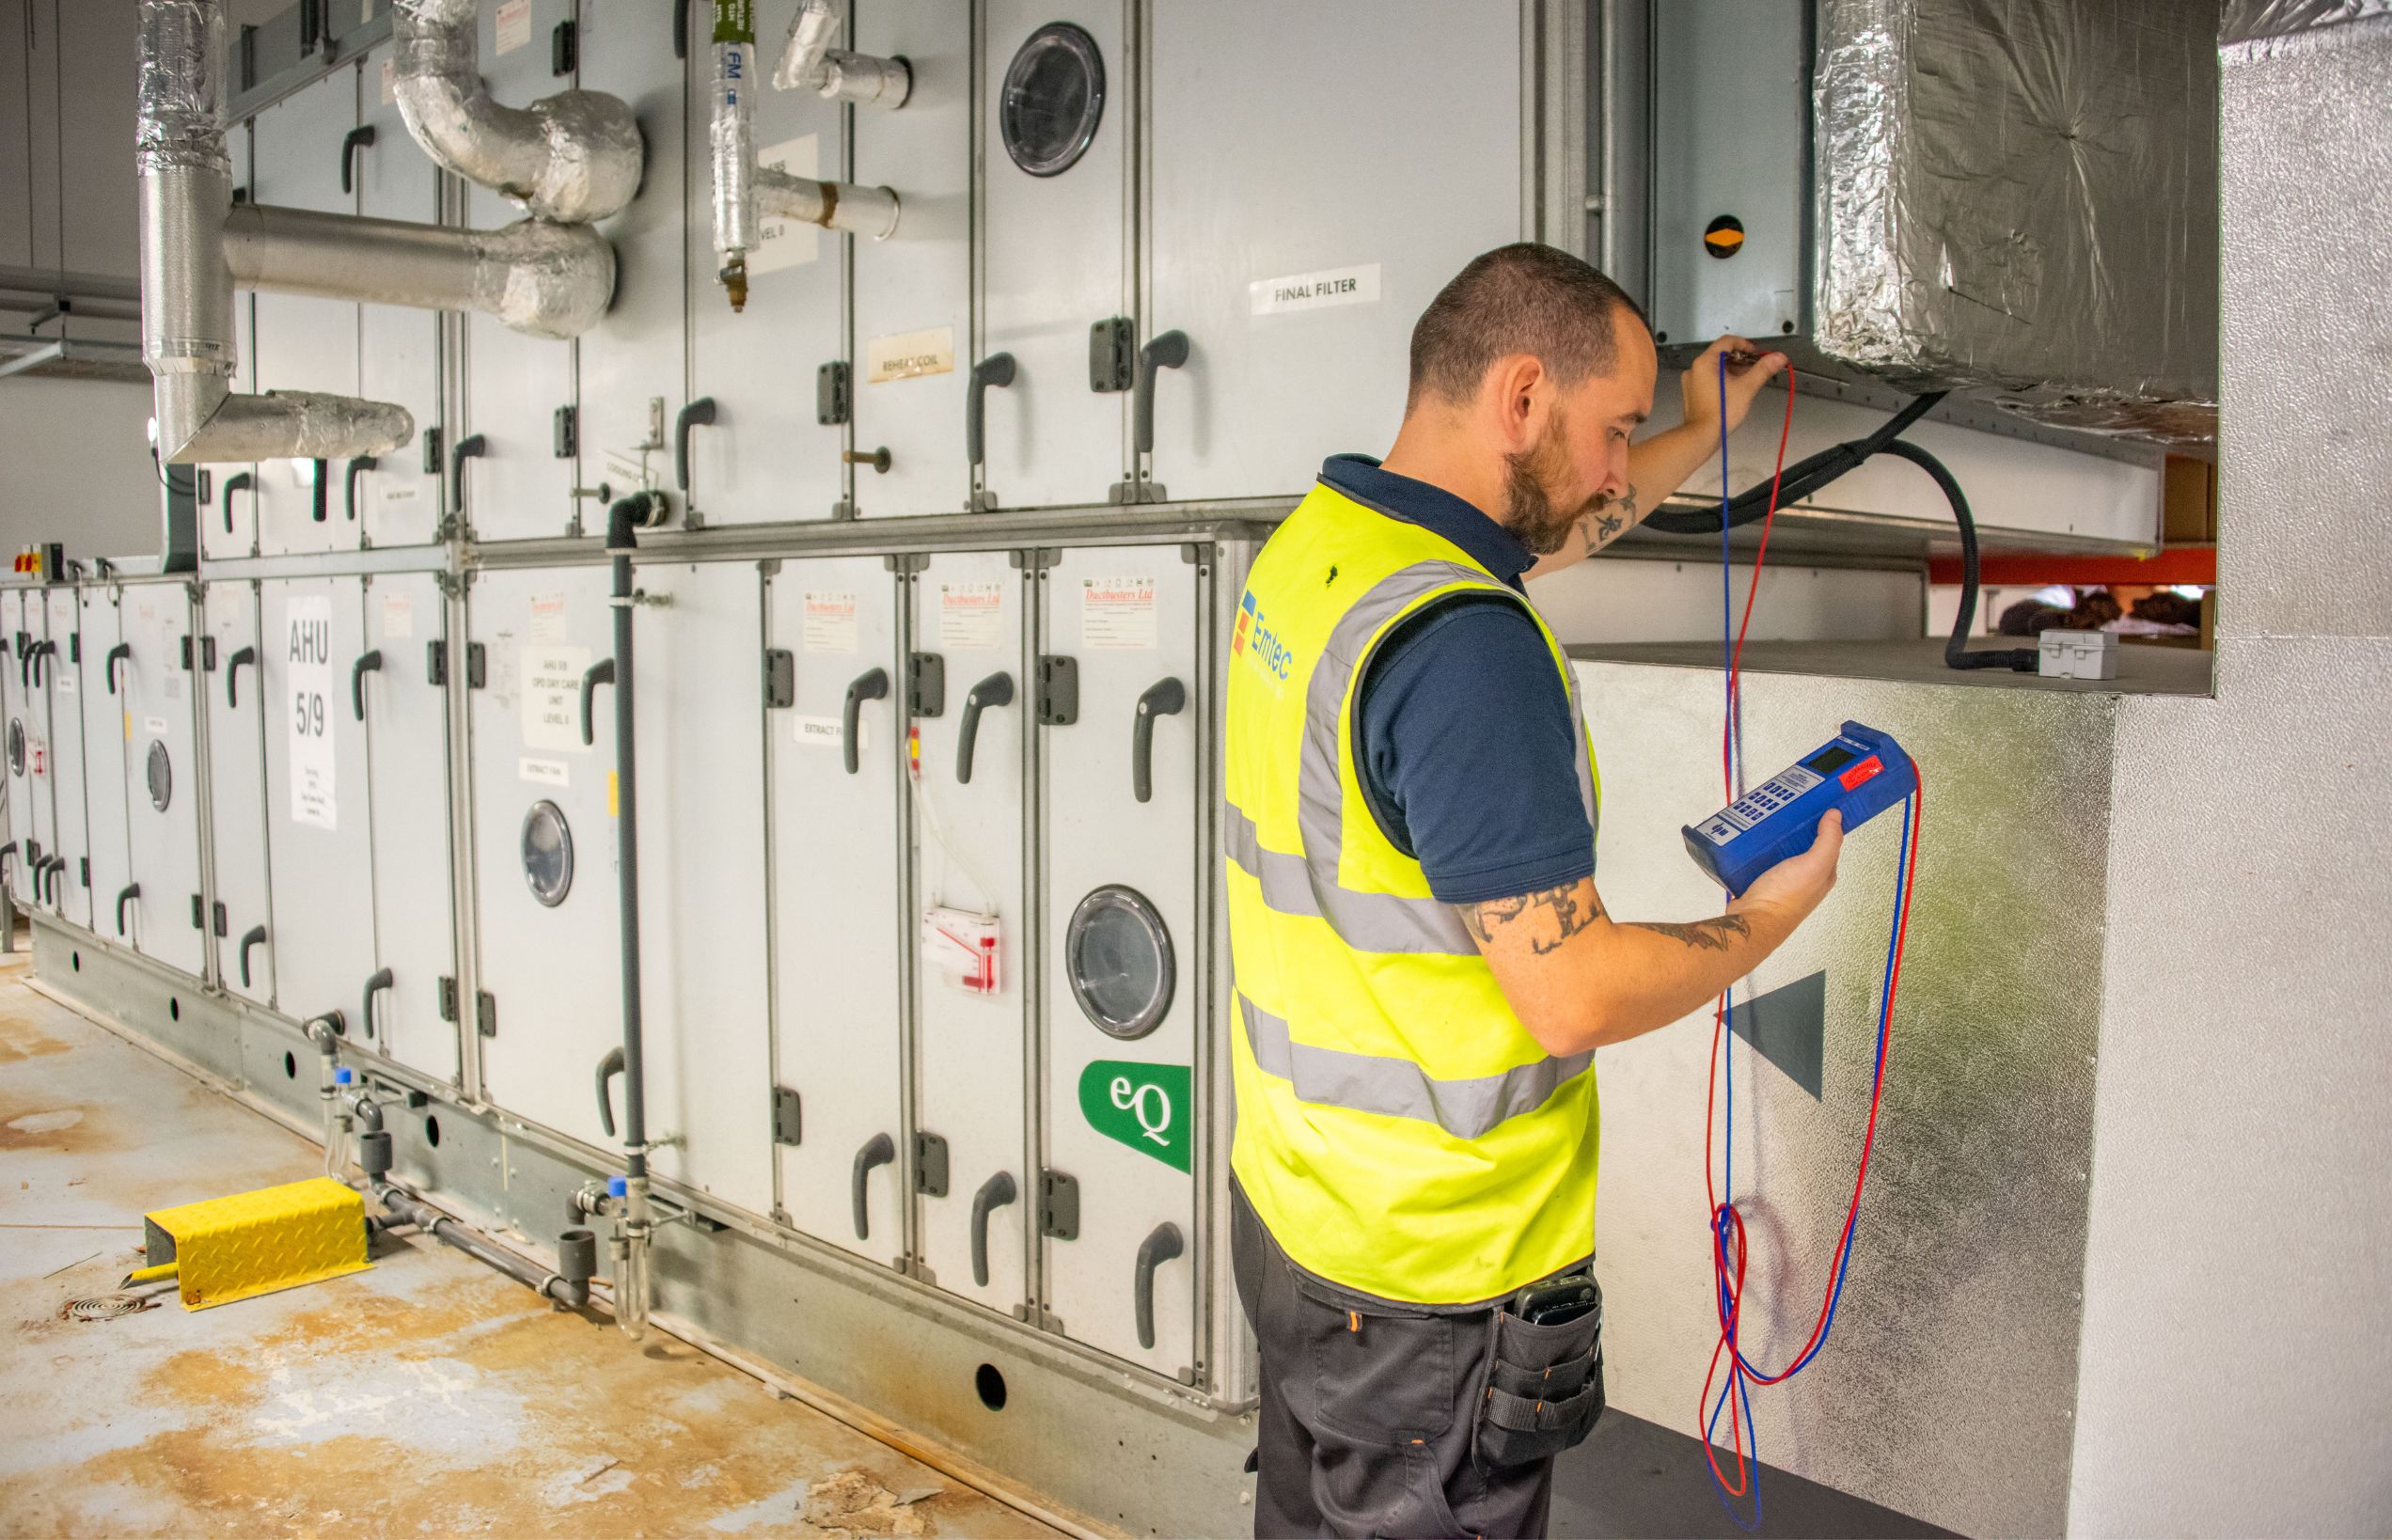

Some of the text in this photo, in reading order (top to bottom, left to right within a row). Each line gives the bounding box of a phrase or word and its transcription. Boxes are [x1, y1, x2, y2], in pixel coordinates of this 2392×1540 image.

[1275, 278, 1357, 302] FINAL FILTER
[917, 354, 937, 367] COIL
[289, 619, 328, 665] AHU
[1251, 611, 1292, 680] Emtec
[296, 691, 323, 737] 5/9
[805, 723, 834, 736] EXTRACT
[1110, 1076, 1171, 1147] eQ
